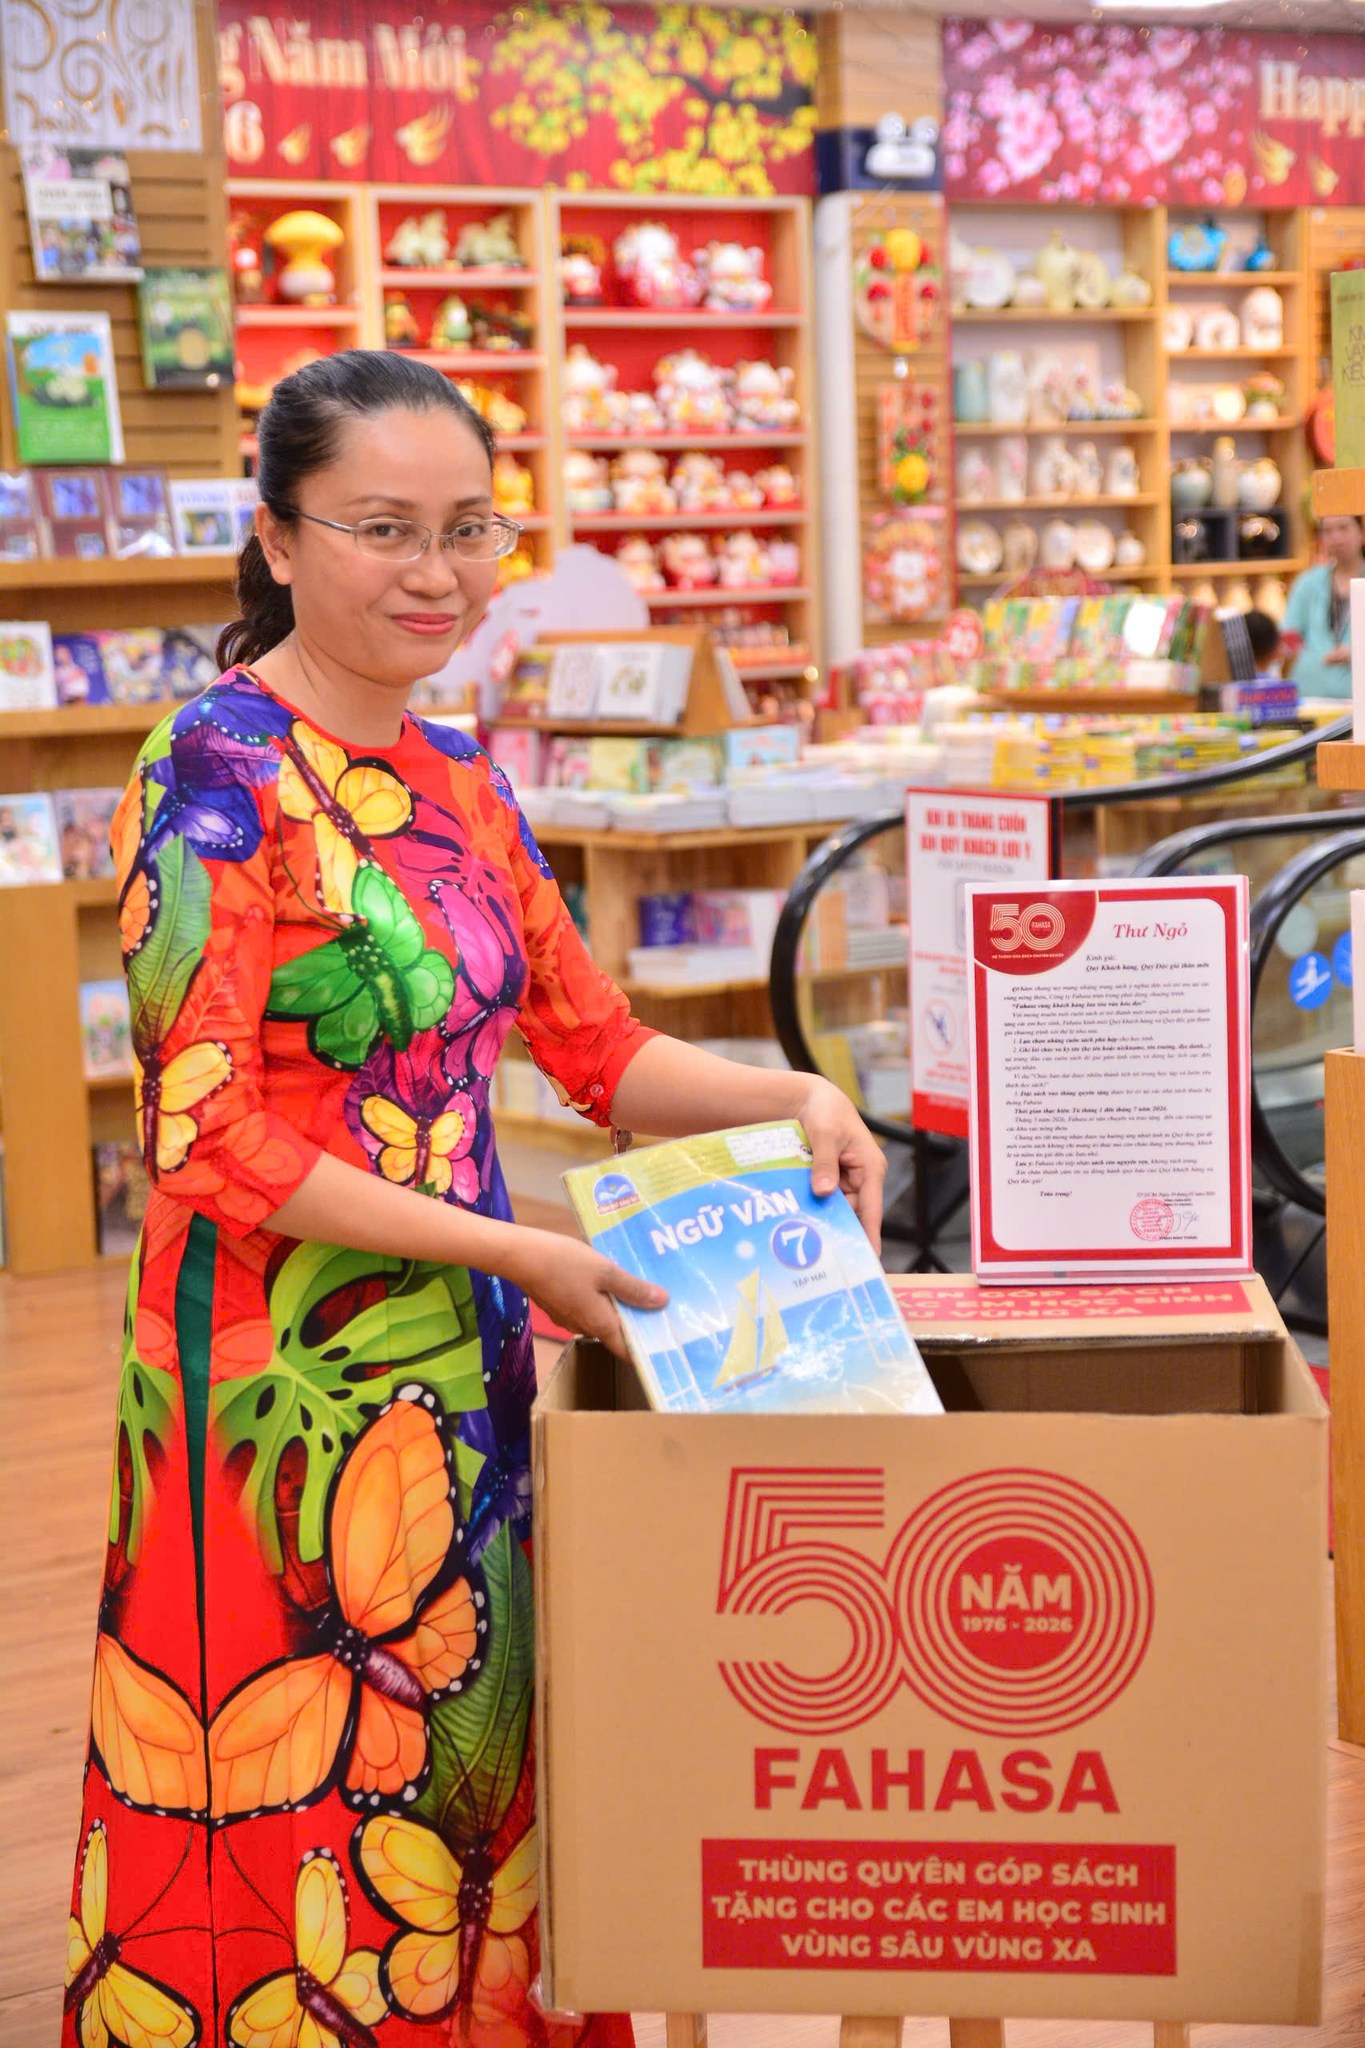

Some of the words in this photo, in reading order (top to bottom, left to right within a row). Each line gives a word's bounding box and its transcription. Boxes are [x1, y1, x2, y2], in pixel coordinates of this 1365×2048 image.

[247, 15, 368, 88] Năm
[374, 22, 469, 92] Mới
[990, 902, 1066, 951] 50
[1113, 923, 1149, 938] Thư
[1153, 922, 1188, 941] Ngỏ
[650, 1204, 724, 1256] NGỮ
[730, 1187, 800, 1227] VĂN
[781, 1226, 808, 1265] 7
[956, 1300, 1015, 1308] EM
[1133, 1293, 1233, 1304] SINH
[1084, 1306, 1142, 1315] XA
[715, 1467, 1155, 1739] 50
[960, 1562, 1072, 1611] NĂM
[961, 1616, 1006, 1632] 1976
[1024, 1616, 1072, 1632] 2026
[754, 1748, 1121, 1814] FAHASA
[738, 1853, 848, 1882] THÙNG
[857, 1855, 966, 1887] QUYÊN
[975, 1857, 1043, 1885] GÓP
[1051, 1858, 1139, 1887] SÁCH
[711, 1890, 798, 1924] TẶNG
[806, 1898, 874, 1920] CHO
[883, 1892, 948, 1921] CÁC
[957, 1899, 1003, 1922] EM
[1012, 1900, 1082, 1929] HỌC
[1090, 1902, 1165, 1925] SINH
[782, 1928, 871, 1958] VÙNG
[879, 1929, 944, 1958] SÂU
[953, 1931, 1043, 1960] VÙNG
[1052, 1938, 1097, 1961] XA
